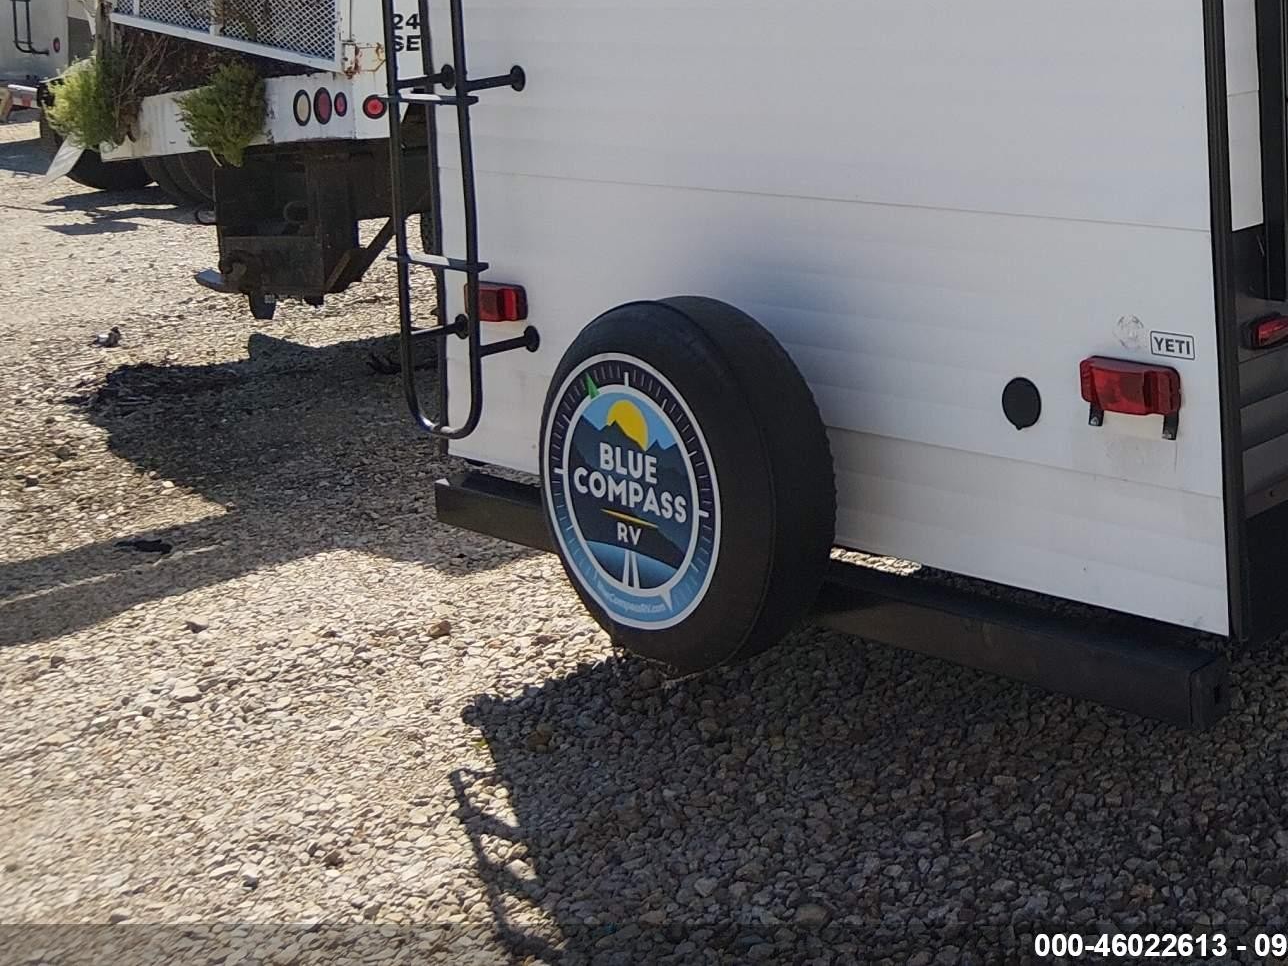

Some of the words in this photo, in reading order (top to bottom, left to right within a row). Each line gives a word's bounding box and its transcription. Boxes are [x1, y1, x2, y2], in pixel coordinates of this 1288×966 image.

[1153, 336, 1191, 355] YETI
[600, 442, 658, 484] BLUE
[573, 466, 687, 524] COMPASS
[617, 521, 642, 546] RV
